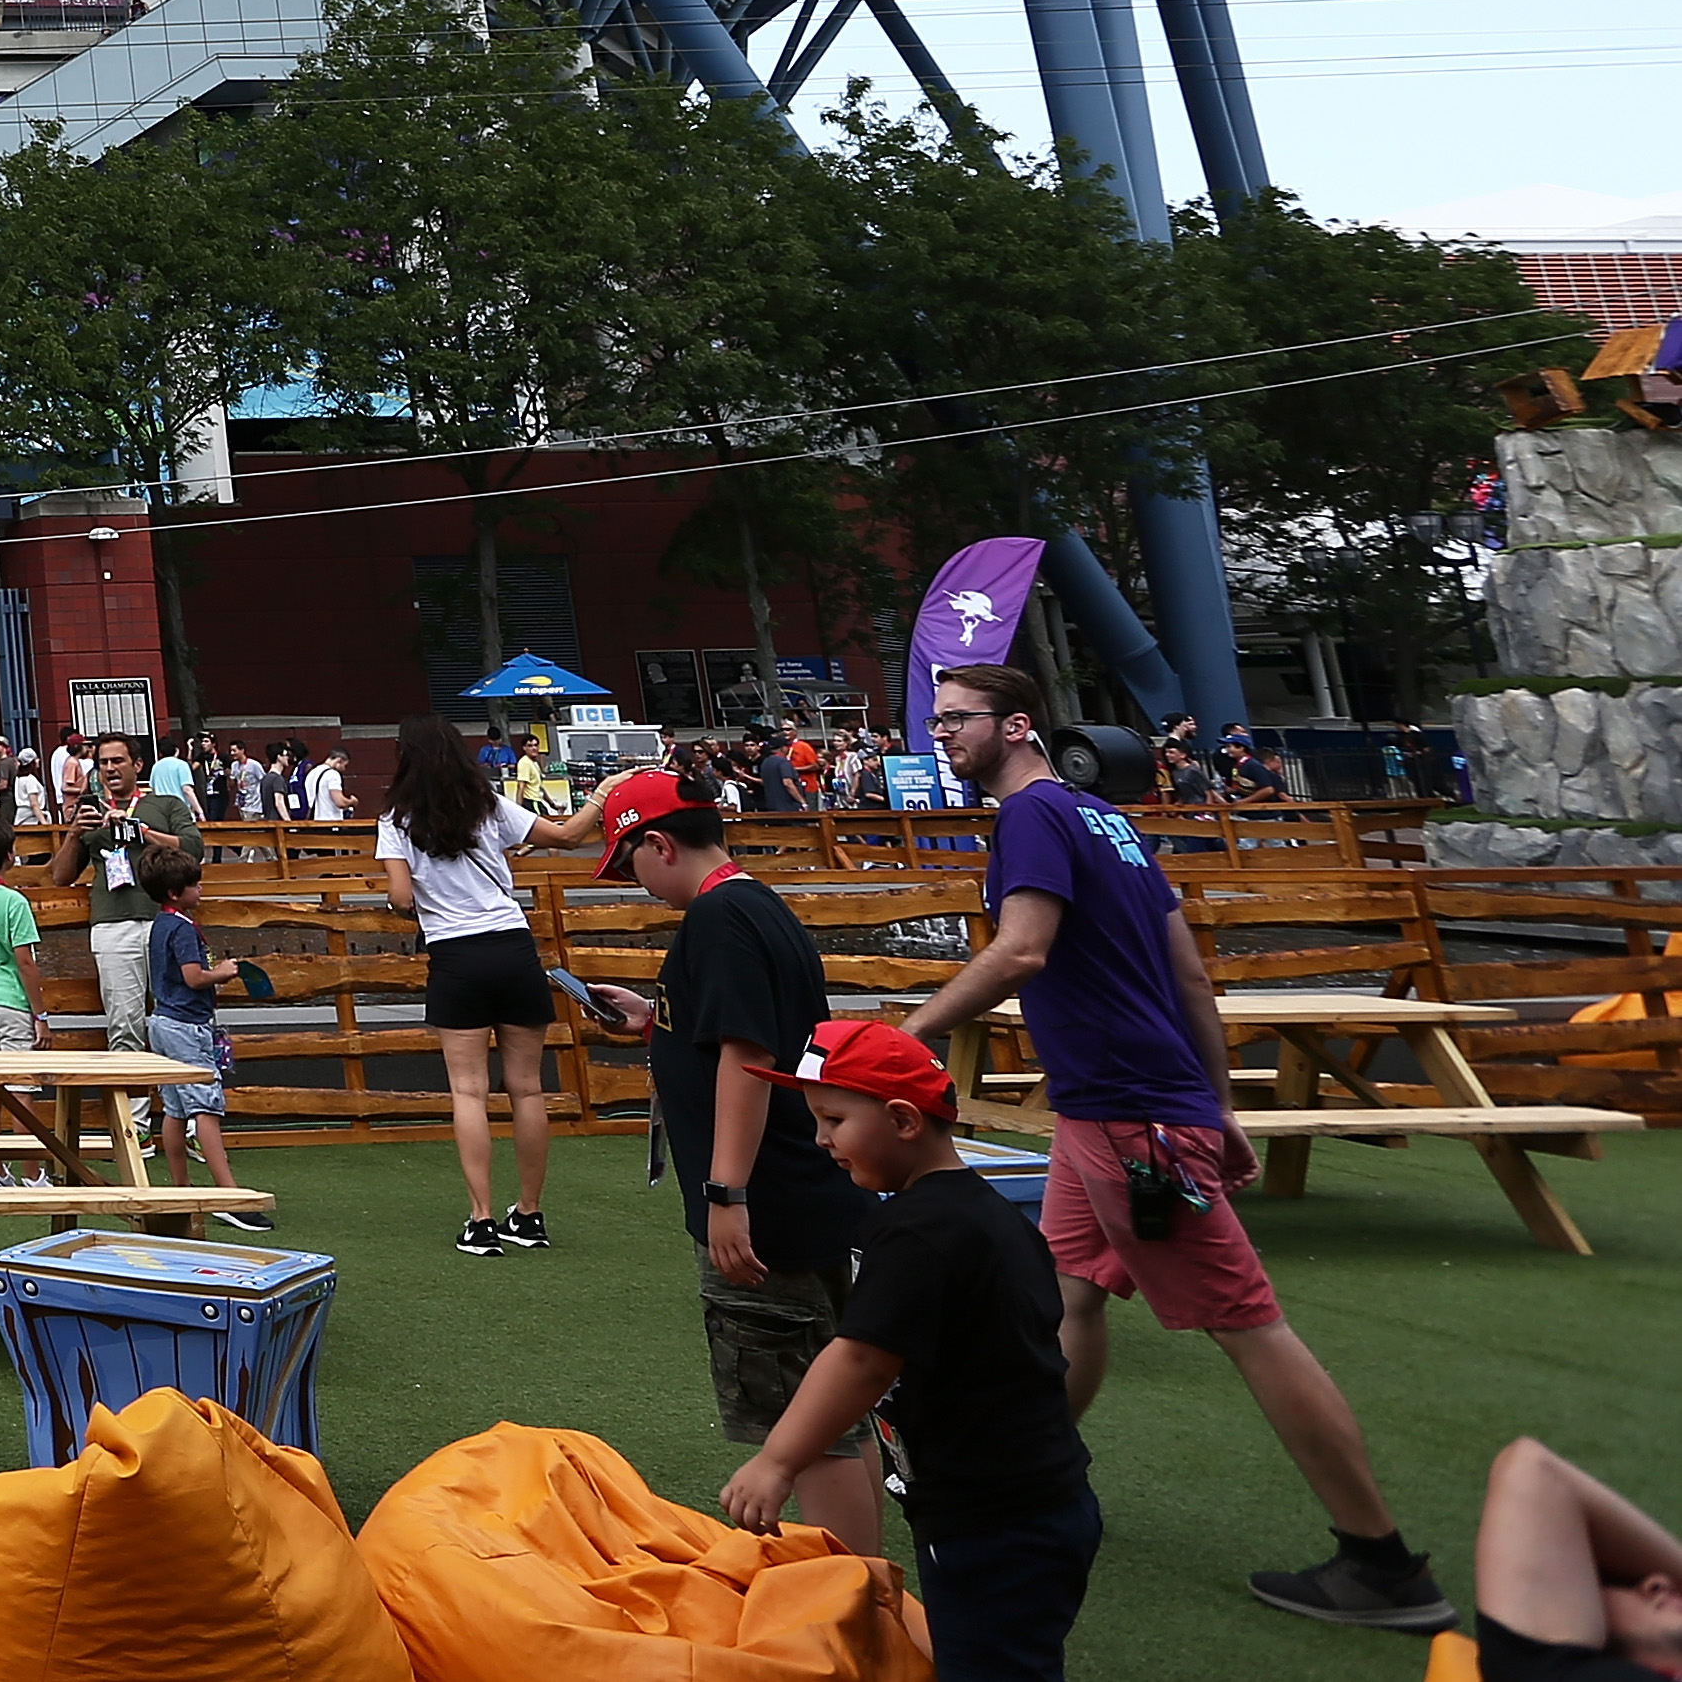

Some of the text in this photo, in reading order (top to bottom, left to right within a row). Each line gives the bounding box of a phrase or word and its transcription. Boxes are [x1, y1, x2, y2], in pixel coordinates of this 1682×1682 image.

[530, 687, 565, 695] open
[575, 708, 616, 722] ICE
[891, 775, 935, 785] WAIT TIME
